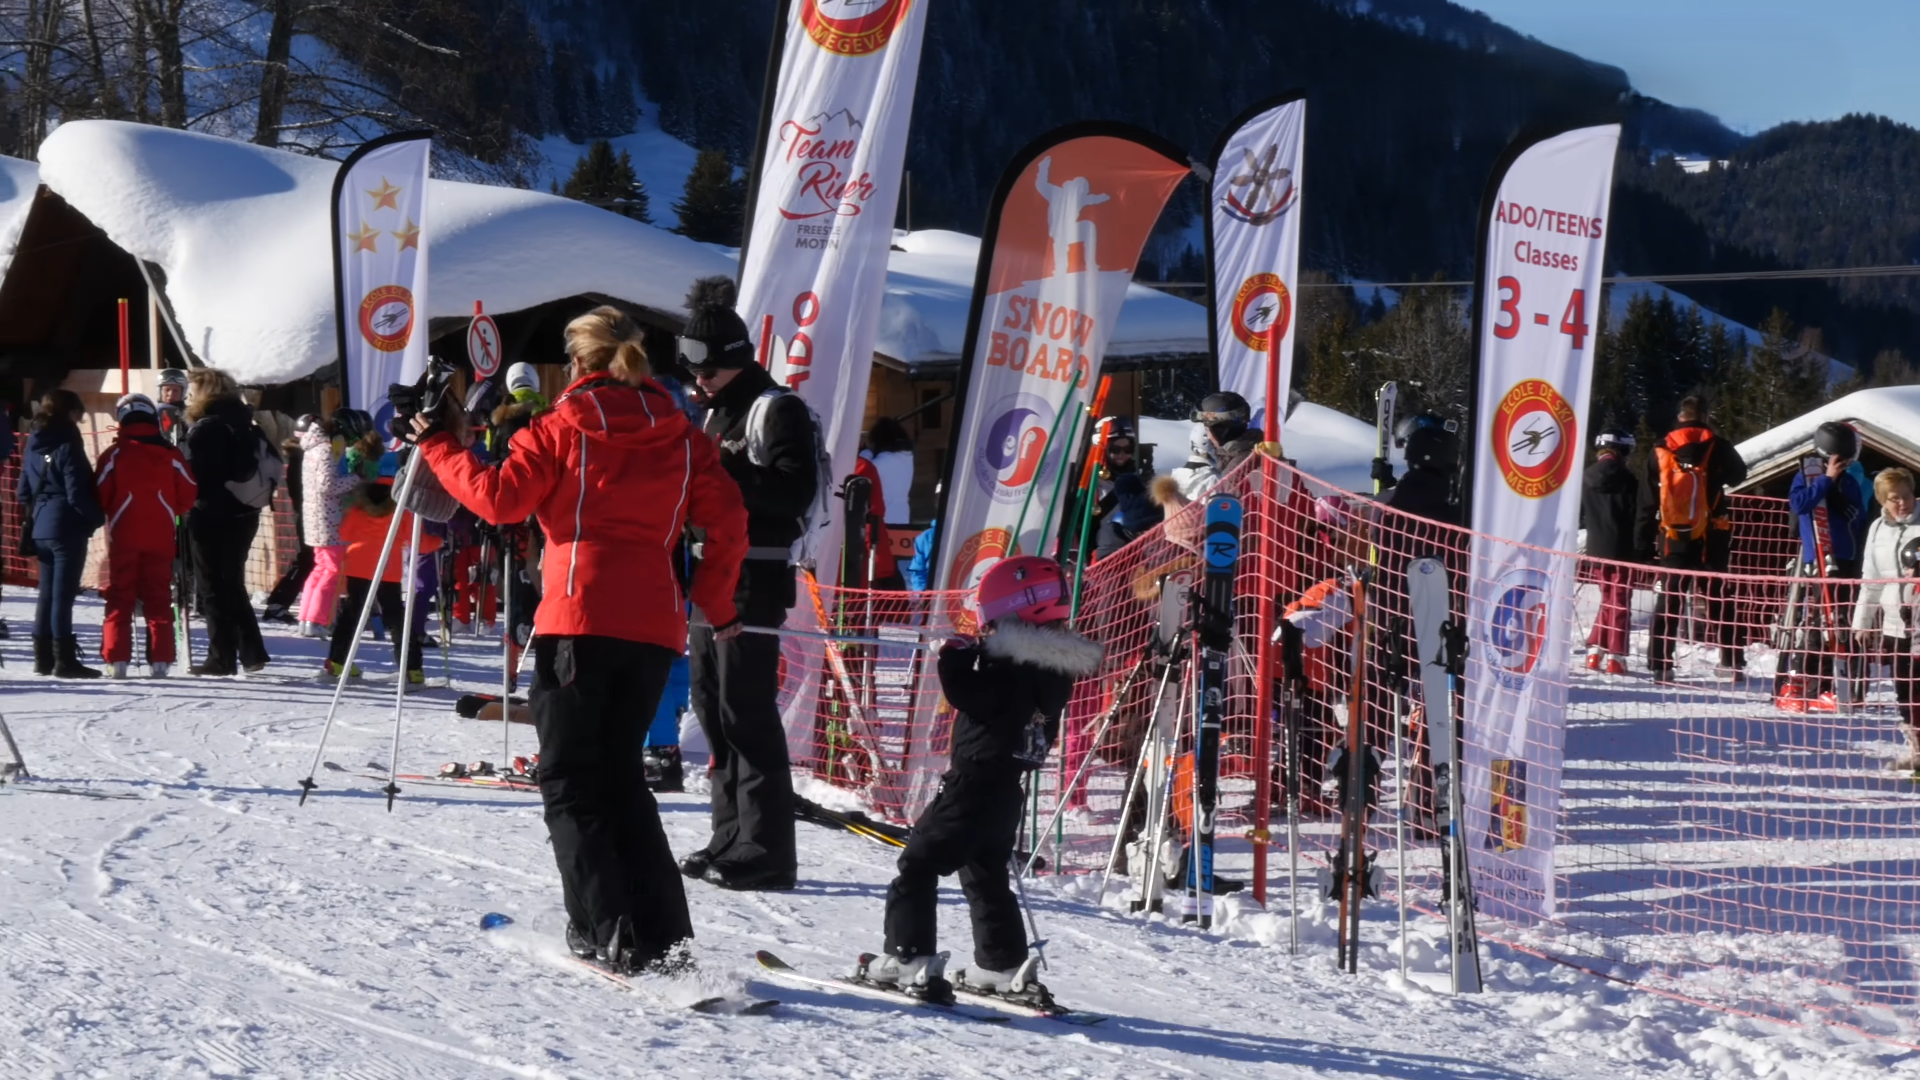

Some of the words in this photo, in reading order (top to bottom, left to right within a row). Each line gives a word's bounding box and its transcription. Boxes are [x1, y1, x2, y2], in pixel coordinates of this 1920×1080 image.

[811, 25, 887, 53] MEGEVE
[780, 120, 857, 164] Team
[1496, 200, 1603, 239] ADO/TEENS
[1514, 240, 1579, 272] Classes
[363, 287, 386, 308] ECOLE
[392, 286, 404, 297] DE
[1236, 277, 1261, 302] ECOLE
[1265, 275, 1278, 286] DE
[1003, 294, 1094, 347] SNOW
[987, 331, 1090, 389] BOARD
[1502, 382, 1535, 415] ECOLE
[1539, 384, 1555, 402] DE
[1553, 399, 1573, 423] SKI
[1382, 398, 1391, 461] HEAD
[1507, 471, 1559, 496] MEGEVE
[958, 531, 993, 562] ECOLE
